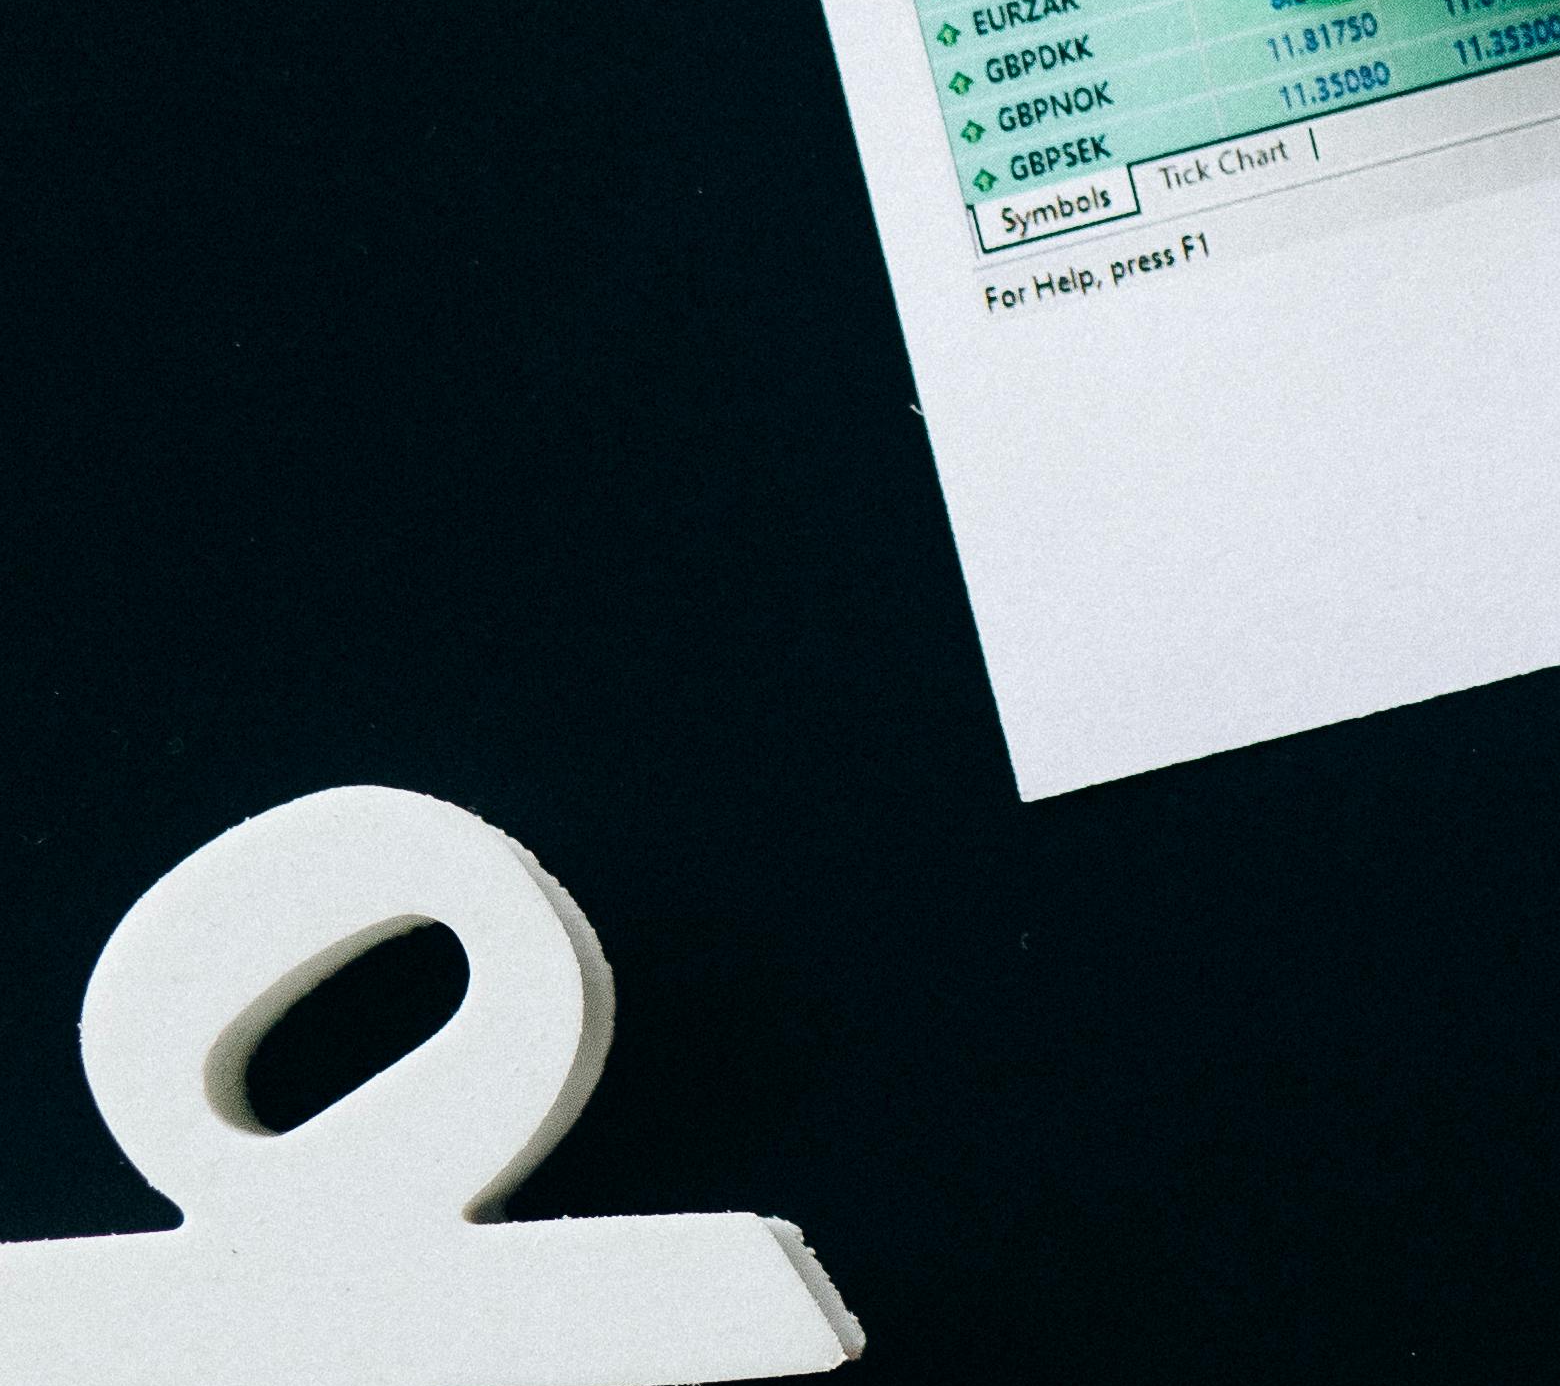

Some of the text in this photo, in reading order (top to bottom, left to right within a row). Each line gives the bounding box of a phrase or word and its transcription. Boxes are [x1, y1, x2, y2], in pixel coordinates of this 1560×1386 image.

[985, 34, 1095, 86] GBPDKK
[1266, 11, 1379, 63] 11.81750
[998, 81, 1115, 135] GBPNOK
[1279, 59, 1392, 111] 11.35080
[1010, 133, 1113, 183] GBPSEK
[1158, 140, 1290, 191] Tick Chart
[1000, 185, 1114, 239] Symbols
[984, 231, 1212, 314] For Help, press F1
